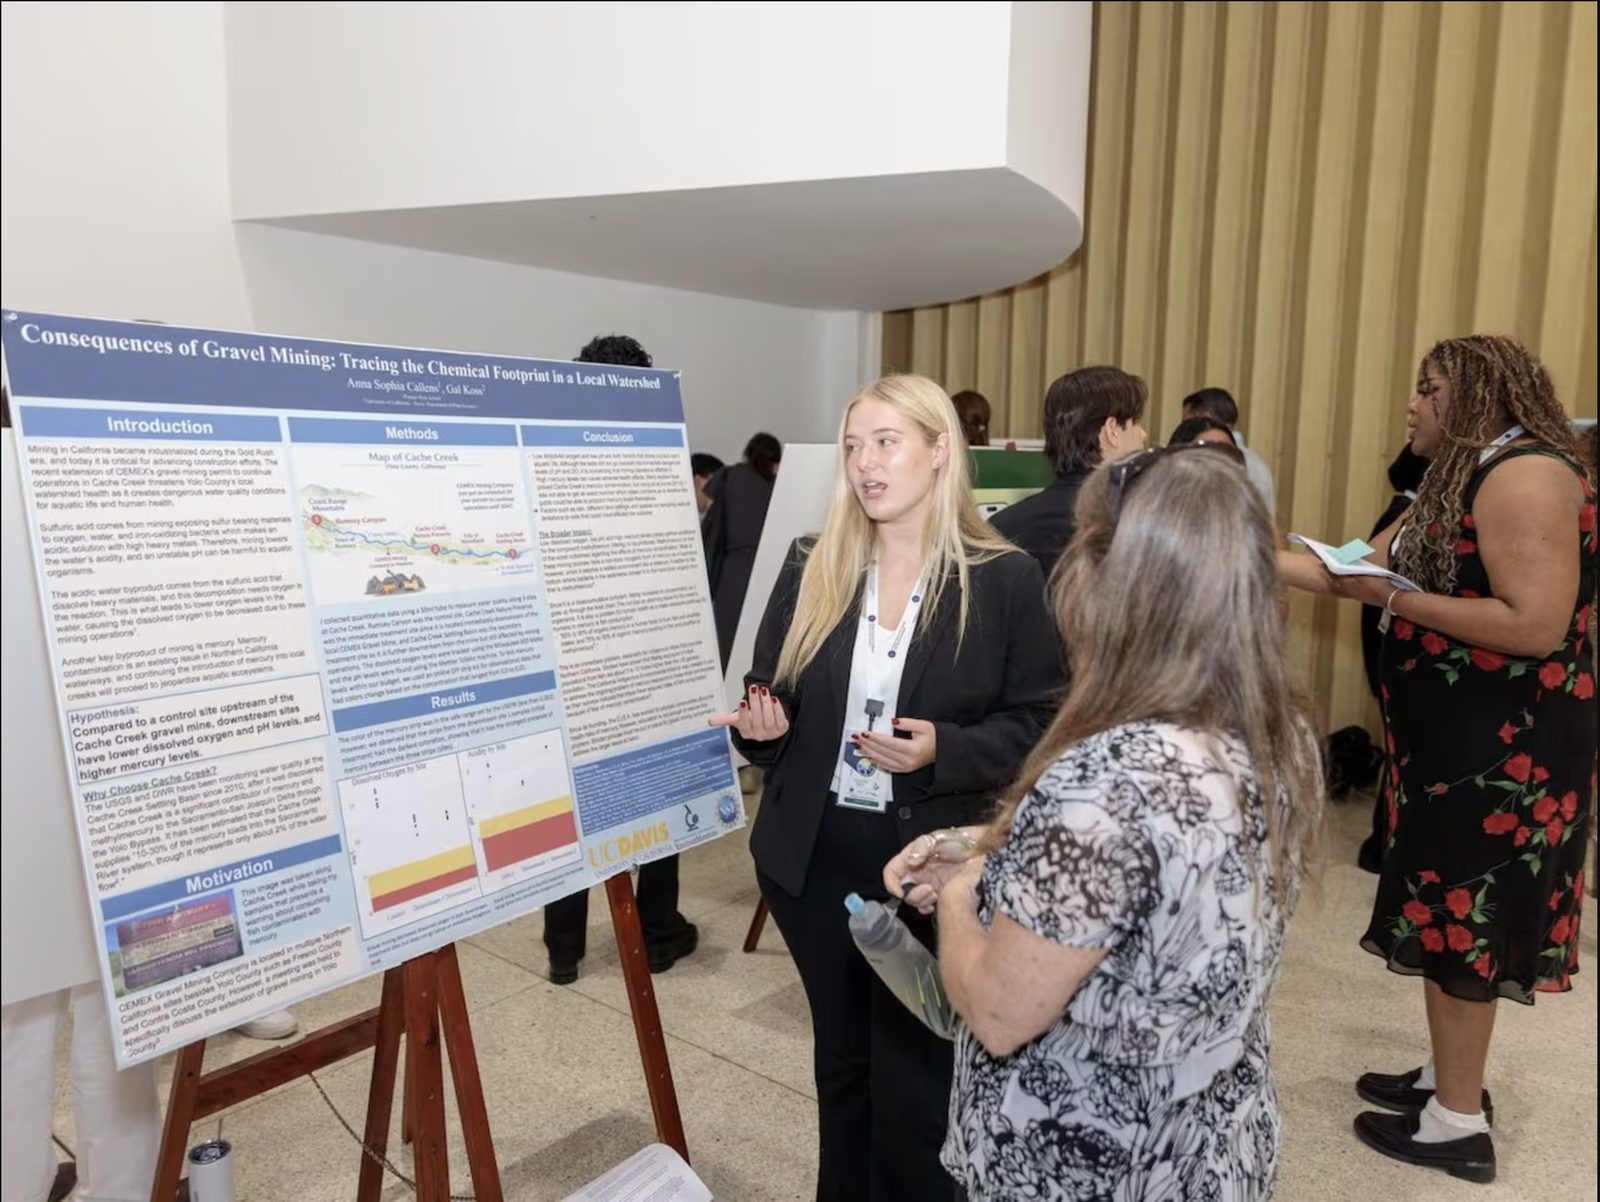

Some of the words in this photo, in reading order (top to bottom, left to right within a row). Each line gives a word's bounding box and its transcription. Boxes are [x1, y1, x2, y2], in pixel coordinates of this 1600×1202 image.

[20, 324, 173, 354] Consequences
[177, 339, 200, 356] of
[201, 340, 265, 361] Gravel
[269, 346, 336, 371] Mining:
[339, 353, 399, 376] Tracing
[401, 358, 424, 373] the
[426, 360, 489, 378] Chemical
[492, 364, 550, 384] Footprint
[552, 369, 564, 382] in
[565, 373, 573, 383] a
[576, 371, 606, 385] Local
[607, 373, 660, 388] Watershed
[346, 378, 372, 388] Anna
[373, 379, 405, 392] Sophia
[445, 384, 461, 393] Gal
[107, 417, 213, 433] Introduction
[385, 426, 439, 439] Methods
[582, 431, 633, 442] Conclusion
[27, 444, 58, 455] Mining
[60, 445, 68, 453] in
[69, 445, 111, 453] California
[112, 446, 146, 454] became
[198, 447, 223, 456] during
[368, 452, 389, 463] Map
[391, 453, 403, 461] of
[404, 453, 432, 461] Cache
[433, 453, 459, 461] Creek
[31, 467, 60, 476] recent
[156, 468, 180, 477] gravel
[182, 468, 208, 477] mining
[208, 468, 232, 477] permit
[39, 522, 74, 531] Sulfuric
[75, 521, 94, 530] acid
[125, 520, 144, 528] from
[146, 519, 173, 528] mining
[174, 518, 210, 527] exposing
[231, 516, 259, 525] bearing
[260, 515, 291, 523] materials
[60, 655, 96, 667] Another
[98, 654, 114, 663] key
[115, 647, 156, 661] byproduct
[158, 646, 167, 654] of
[168, 644, 194, 653] mining
[196, 642, 202, 650] is
[237, 635, 267, 644] Mercury
[70, 705, 139, 724] Hypothesis:
[72, 718, 133, 737] Compared
[134, 717, 147, 727] to
[158, 708, 196, 723] control
[198, 705, 217, 716] site
[220, 698, 266, 713] upstream
[268, 694, 278, 704] of
[279, 692, 294, 702] the
[430, 690, 476, 709] Results
[74, 737, 112, 751] Cache
[114, 730, 147, 744] Creek
[150, 723, 184, 740] gravel
[186, 721, 214, 731] mine,
[216, 709, 277, 726] downstream
[279, 705, 299, 715] sites
[77, 753, 106, 766] have
[108, 747, 140, 760] lower
[141, 735, 194, 753] dissolved
[196, 730, 234, 743] oxygen
[235, 724, 254, 736] and
[256, 721, 270, 734] pH
[272, 717, 302, 729] levels,
[303, 712, 320, 723] and
[79, 765, 117, 780] higher
[120, 756, 166, 771] mercury
[168, 749, 201, 762] levels.
[83, 789, 107, 801] Why
[108, 781, 148, 796] Choose
[151, 774, 181, 787] Cache
[184, 765, 217, 780] Creek?
[85, 802, 102, 812] The
[104, 795, 132, 808] USGS
[134, 791, 150, 802] and
[151, 785, 174, 798] DWR
[176, 783, 196, 792] have
[197, 778, 217, 788] been
[218, 769, 258, 783] monitoring
[259, 764, 278, 774] water
[280, 759, 303, 771] quality
[304, 756, 310, 764] at
[311, 754, 323, 763] the
[183, 858, 275, 894] Motivation
[241, 887, 256, 897] This
[257, 881, 278, 892] image
[280, 876, 293, 885] was
[294, 870, 313, 881] taken
[315, 865, 331, 875] along
[241, 895, 265, 907] Cache
[266, 887, 287, 899] Creek
[288, 882, 306, 893] while
[307, 876, 327, 887] taking
[244, 902, 273, 917] samples
[274, 896, 288, 907] that
[289, 888, 317, 904] presents
[245, 912, 274, 927] warning
[275, 904, 294, 917] about
[295, 894, 330, 910] consuming
[246, 926, 260, 936] fish
[261, 910, 307, 932] contaminated
[308, 906, 321, 916] with
[118, 993, 152, 1012] CEMEX
[154, 983, 182, 1000] Gravel
[183, 974, 211, 989] Mining
[211, 961, 249, 979] Company
[250, 958, 257, 966] is
[258, 947, 285, 963] located
[286, 945, 293, 953] in
[294, 936, 321, 950] multiple
[322, 925, 351, 940] Northern
